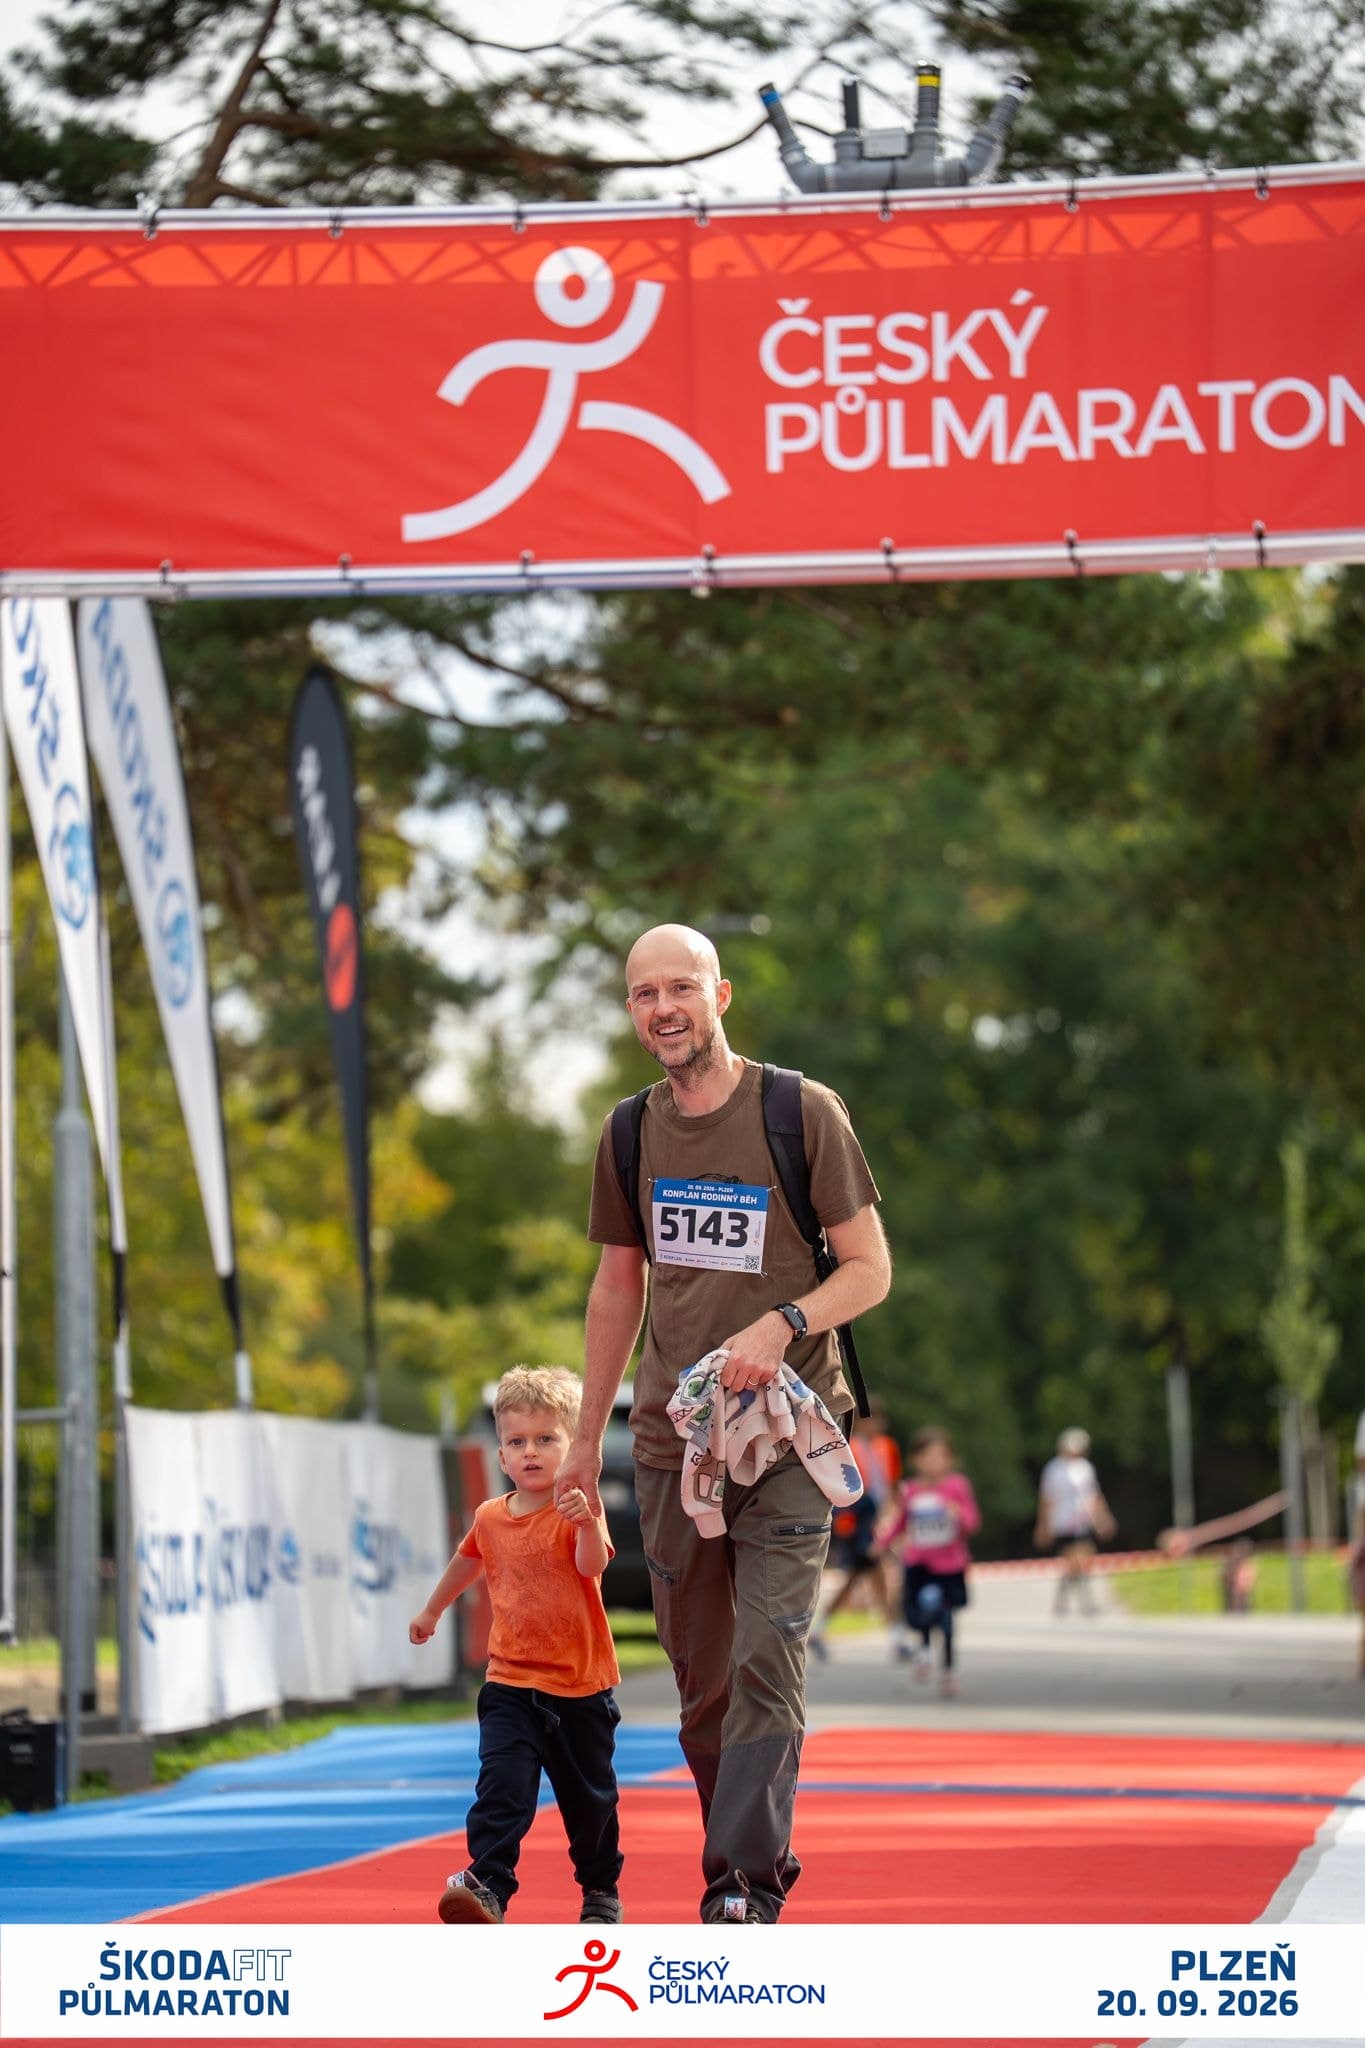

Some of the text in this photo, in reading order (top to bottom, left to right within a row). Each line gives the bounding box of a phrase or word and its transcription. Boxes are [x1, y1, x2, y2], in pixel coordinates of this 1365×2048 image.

[759, 289, 1050, 388] ČESKÝ
[662, 1189, 758, 1205] KONPLAN RODINNÝ BĚH
[660, 1206, 749, 1248] 5143
